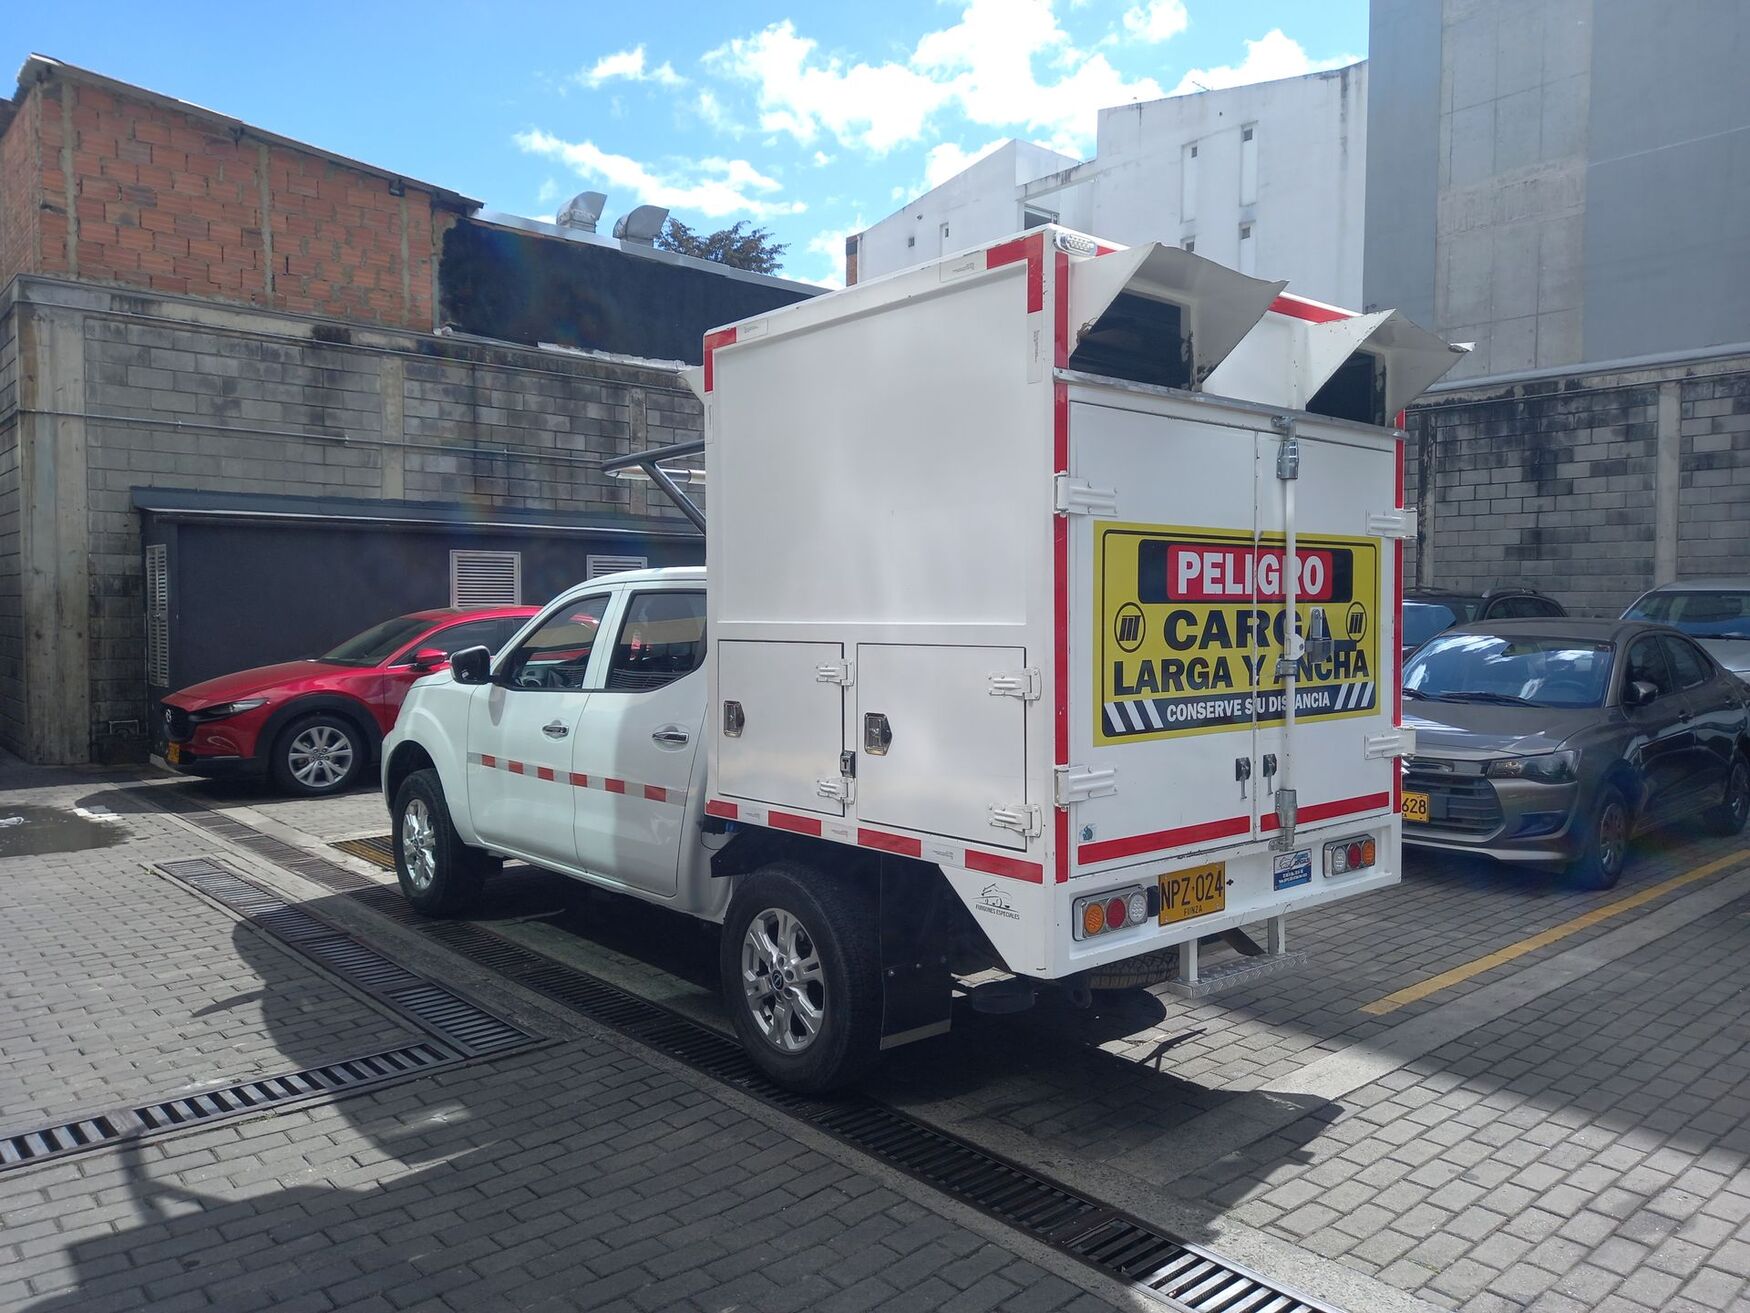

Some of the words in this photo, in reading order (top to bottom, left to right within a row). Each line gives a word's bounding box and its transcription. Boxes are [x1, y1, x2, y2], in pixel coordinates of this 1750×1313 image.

[1178, 551, 1324, 595] PELIGRO
[1114, 656, 1233, 696] LARGA
[1241, 654, 1266, 687] Y
[1167, 699, 1242, 722] CONSERVE
[1245, 696, 1266, 715] SU
[1269, 691, 1330, 712] DISANCIA
[1183, 904, 1203, 916] FUNZA
